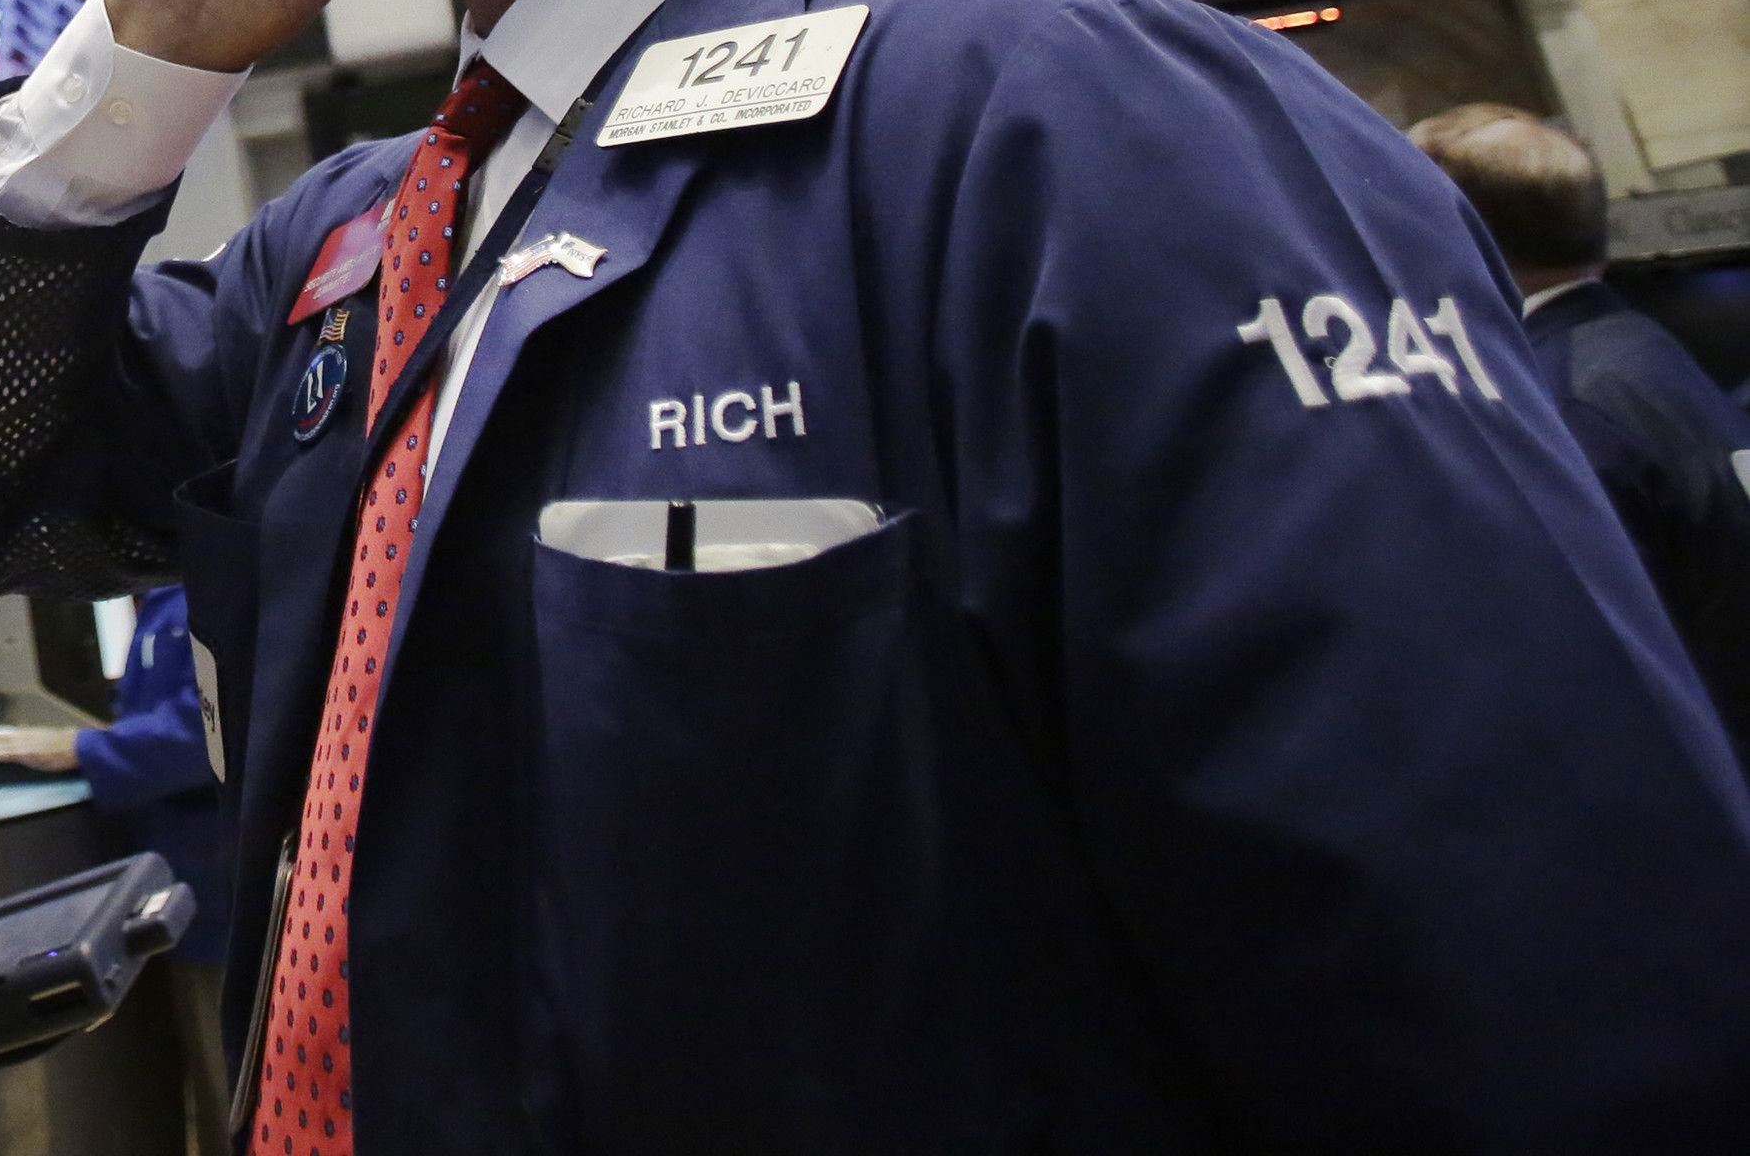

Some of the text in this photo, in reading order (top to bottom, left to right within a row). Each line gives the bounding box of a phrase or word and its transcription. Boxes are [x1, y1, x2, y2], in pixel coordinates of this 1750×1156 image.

[678, 28, 809, 89] 1241
[608, 125, 648, 141] MORGAN
[649, 118, 693, 134] STANLEY
[734, 100, 812, 122] INCORPORATED
[616, 76, 826, 122] RICHARD J. DEVICCARO
[1237, 297, 1502, 407] 1241
[650, 381, 807, 449] RICH
